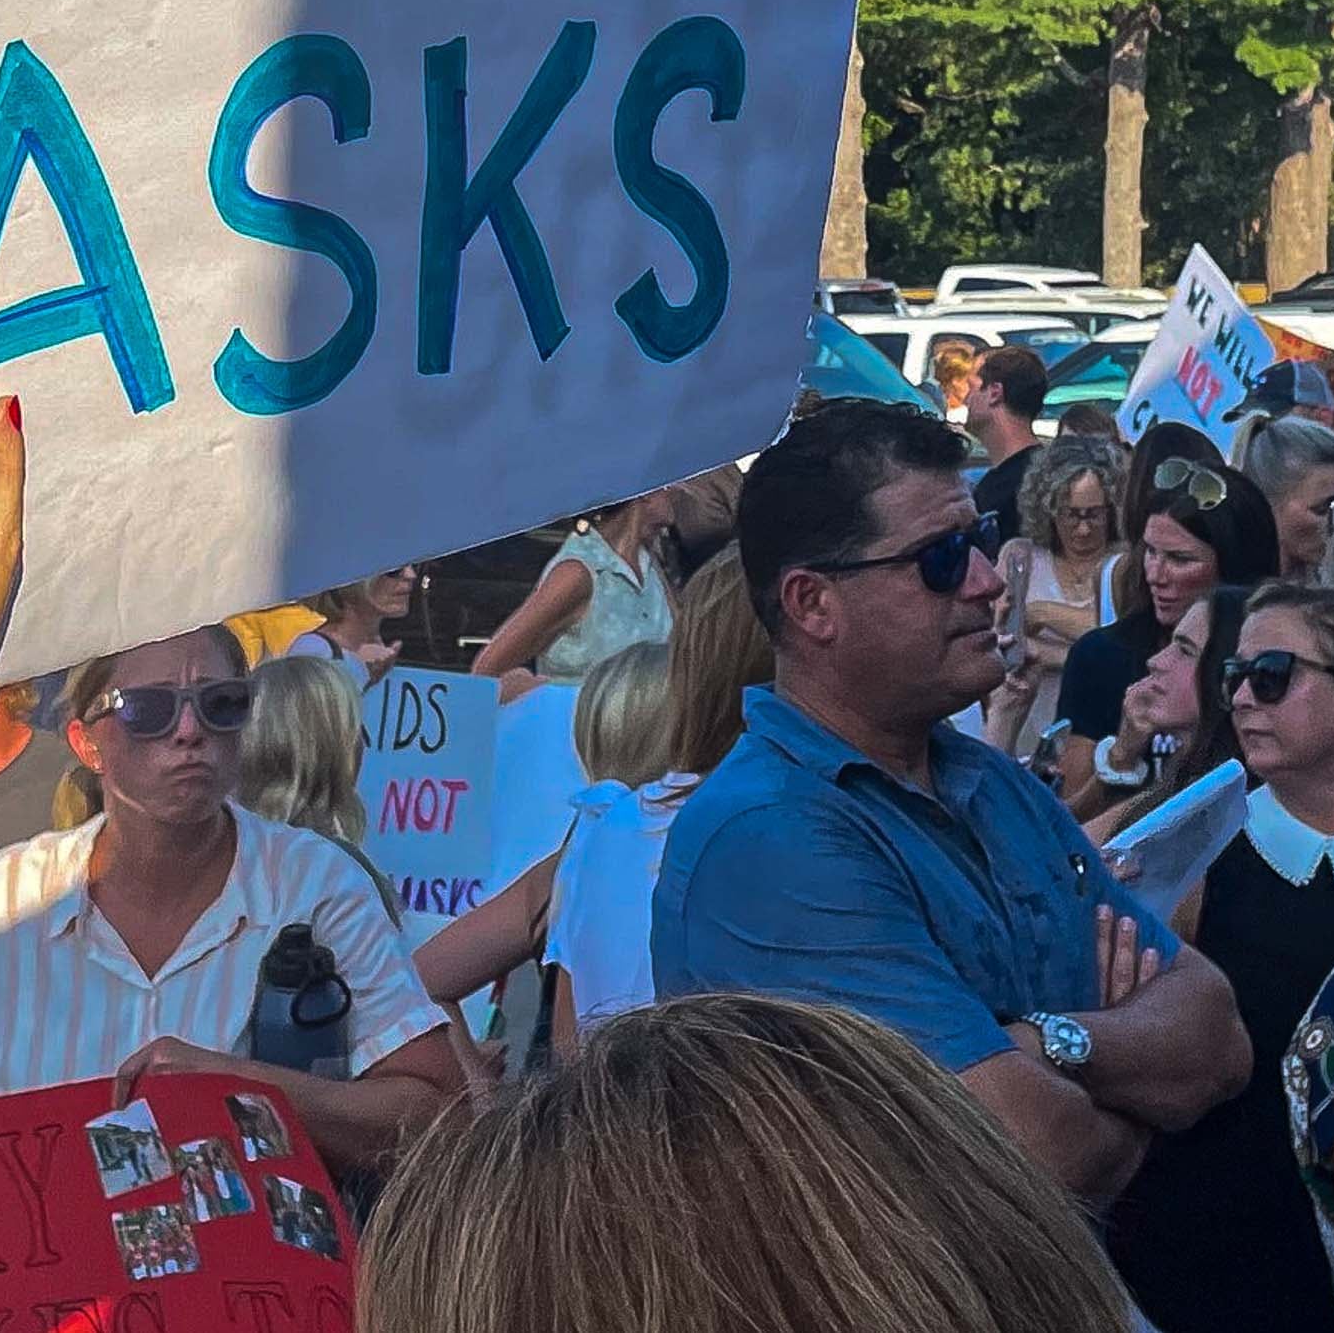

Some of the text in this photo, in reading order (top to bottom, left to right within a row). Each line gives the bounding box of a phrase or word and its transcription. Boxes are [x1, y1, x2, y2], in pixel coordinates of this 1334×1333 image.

[1178, 345, 1225, 416] NOT
[361, 678, 448, 754] IDS
[379, 778, 471, 835] NOT
